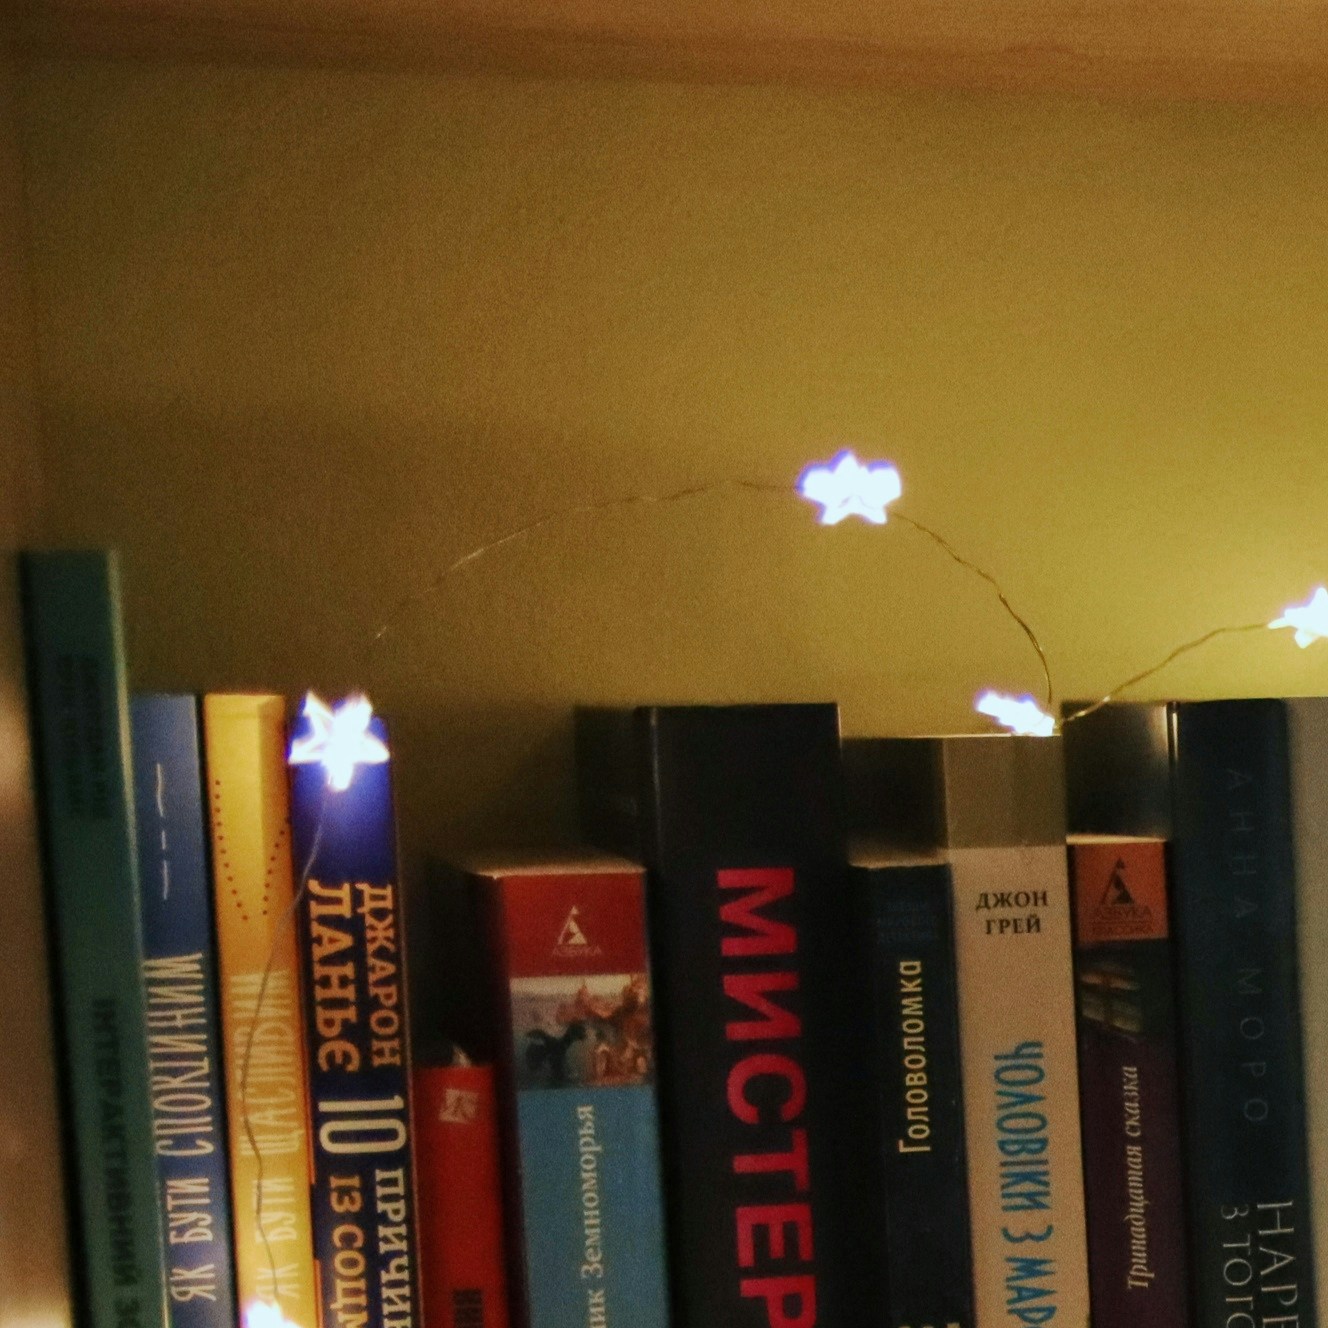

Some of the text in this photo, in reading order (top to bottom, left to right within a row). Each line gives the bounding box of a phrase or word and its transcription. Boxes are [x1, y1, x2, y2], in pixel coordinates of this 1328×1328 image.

[975, 890, 1048, 911] ДЖОН
[985, 913, 1041, 935] ГРЕЙ
[307, 880, 360, 1073] ЛАНЬЄ
[356, 883, 401, 1069] ДЖАРОН
[897, 958, 932, 1152] Головоломка
[318, 1094, 406, 1154] 10
[993, 1041, 1053, 1211] ЧОЛОВІКИ
[328, 1174, 363, 1213] ІЗ
[575, 1105, 604, 1279] Земноморья
[1119, 1065, 1155, 1289] Тринадцатая сказка
[165, 1177, 214, 1242] БУТИ
[1001, 1224, 1055, 1243] З
[1220, 1204, 1250, 1220] З
[169, 1264, 217, 1302] ЯК
